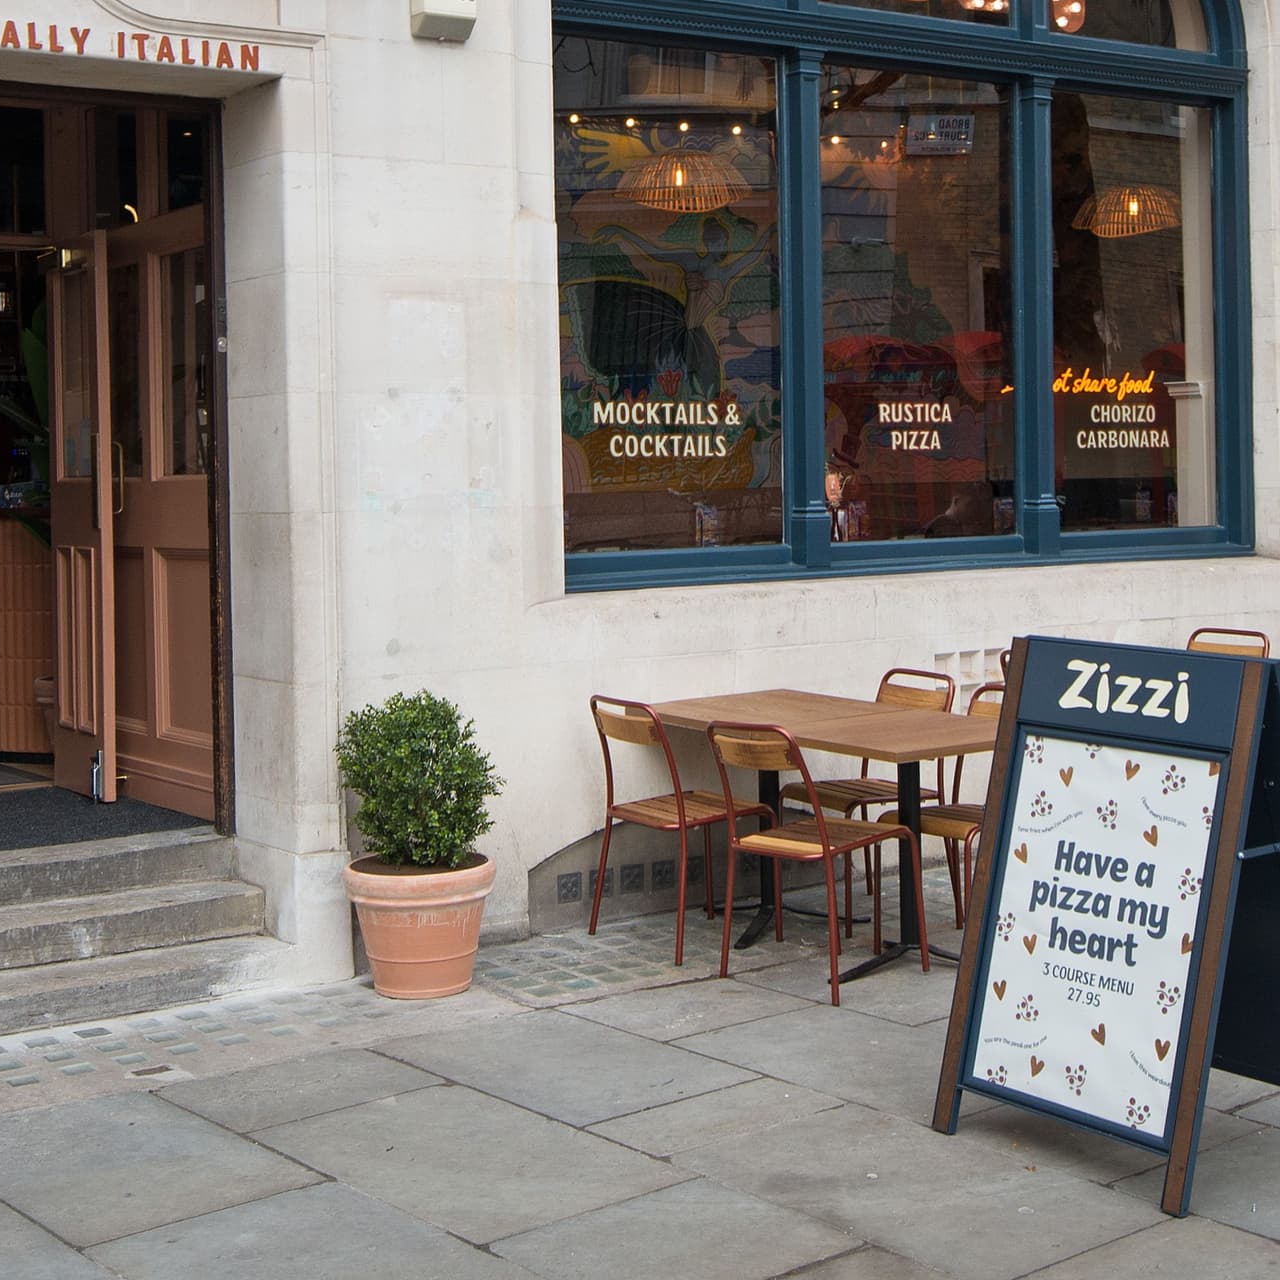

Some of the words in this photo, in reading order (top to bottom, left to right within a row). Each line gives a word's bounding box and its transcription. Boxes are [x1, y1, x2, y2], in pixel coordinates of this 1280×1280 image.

[117, 32, 261, 72] ITALIAN
[1072, 367, 1118, 394] share
[1117, 369, 1156, 402] food
[592, 401, 720, 427] MOCKTAILS
[725, 402, 741, 426] &
[878, 402, 953, 425] RUSTICA
[1089, 403, 1157, 425] CHORIZO
[609, 434, 728, 459] COCKTAILS
[891, 429, 942, 452] PIZZA
[1076, 428, 1170, 451] CARBONARA
[1058, 658, 1191, 724] Zizzi
[1054, 840, 1129, 882] Have
[1135, 861, 1156, 888] a
[1029, 876, 1112, 919] pizza
[1117, 897, 1169, 939] my
[1048, 916, 1138, 967] heart
[1043, 962, 1050, 976] 3
[1052, 964, 1096, 987] COURSE
[1098, 975, 1135, 996] MENU
[1067, 987, 1101, 1007] 27.95
